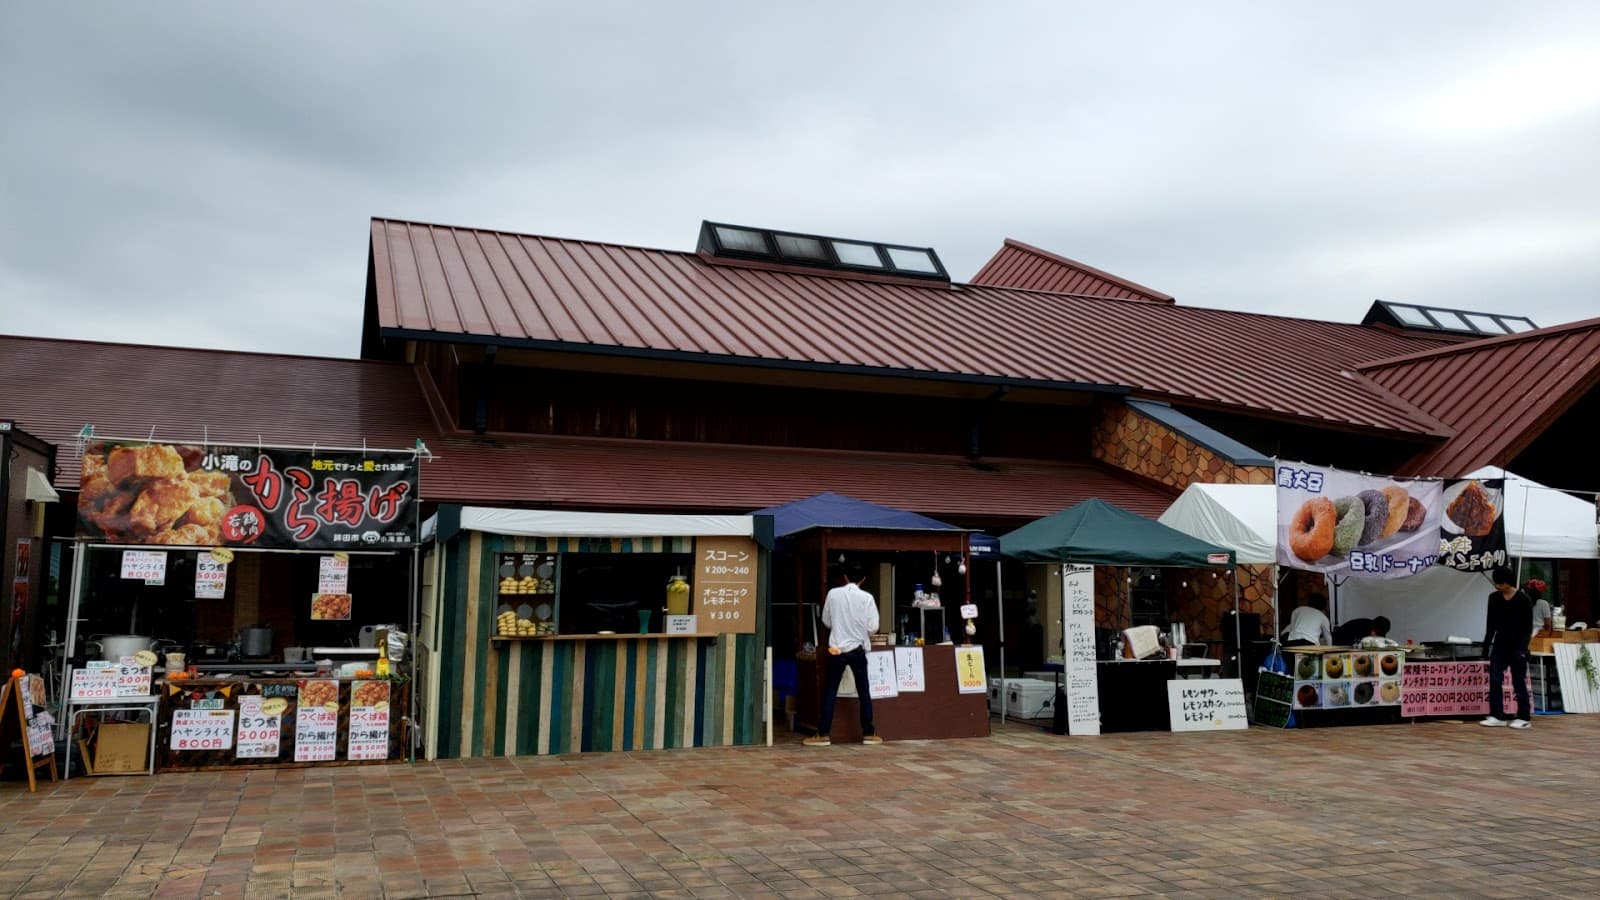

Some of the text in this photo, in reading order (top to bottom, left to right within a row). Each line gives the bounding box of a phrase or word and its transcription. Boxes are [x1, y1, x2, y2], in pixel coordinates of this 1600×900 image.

[202, 454, 252, 471] 小滝の
[1278, 467, 1324, 493] 青大豆
[243, 453, 410, 542] から揚げ
[704, 550, 750, 562] スコーン
[1350, 551, 1438, 575] 豆乳ドーナツ
[703, 587, 749, 597] オーガニック
[703, 596, 741, 606] レモネード
[1402, 692, 1428, 704] 200円
[1429, 691, 1456, 704] 200円
[1456, 690, 1484, 704] 200円
[241, 716, 278, 729] もつ煮
[172, 727, 231, 737] ハヤシライス
[239, 729, 280, 741] 500円
[298, 731, 336, 741] から揚げ
[350, 730, 388, 740] から揚げ
[178, 739, 223, 749] 800円
